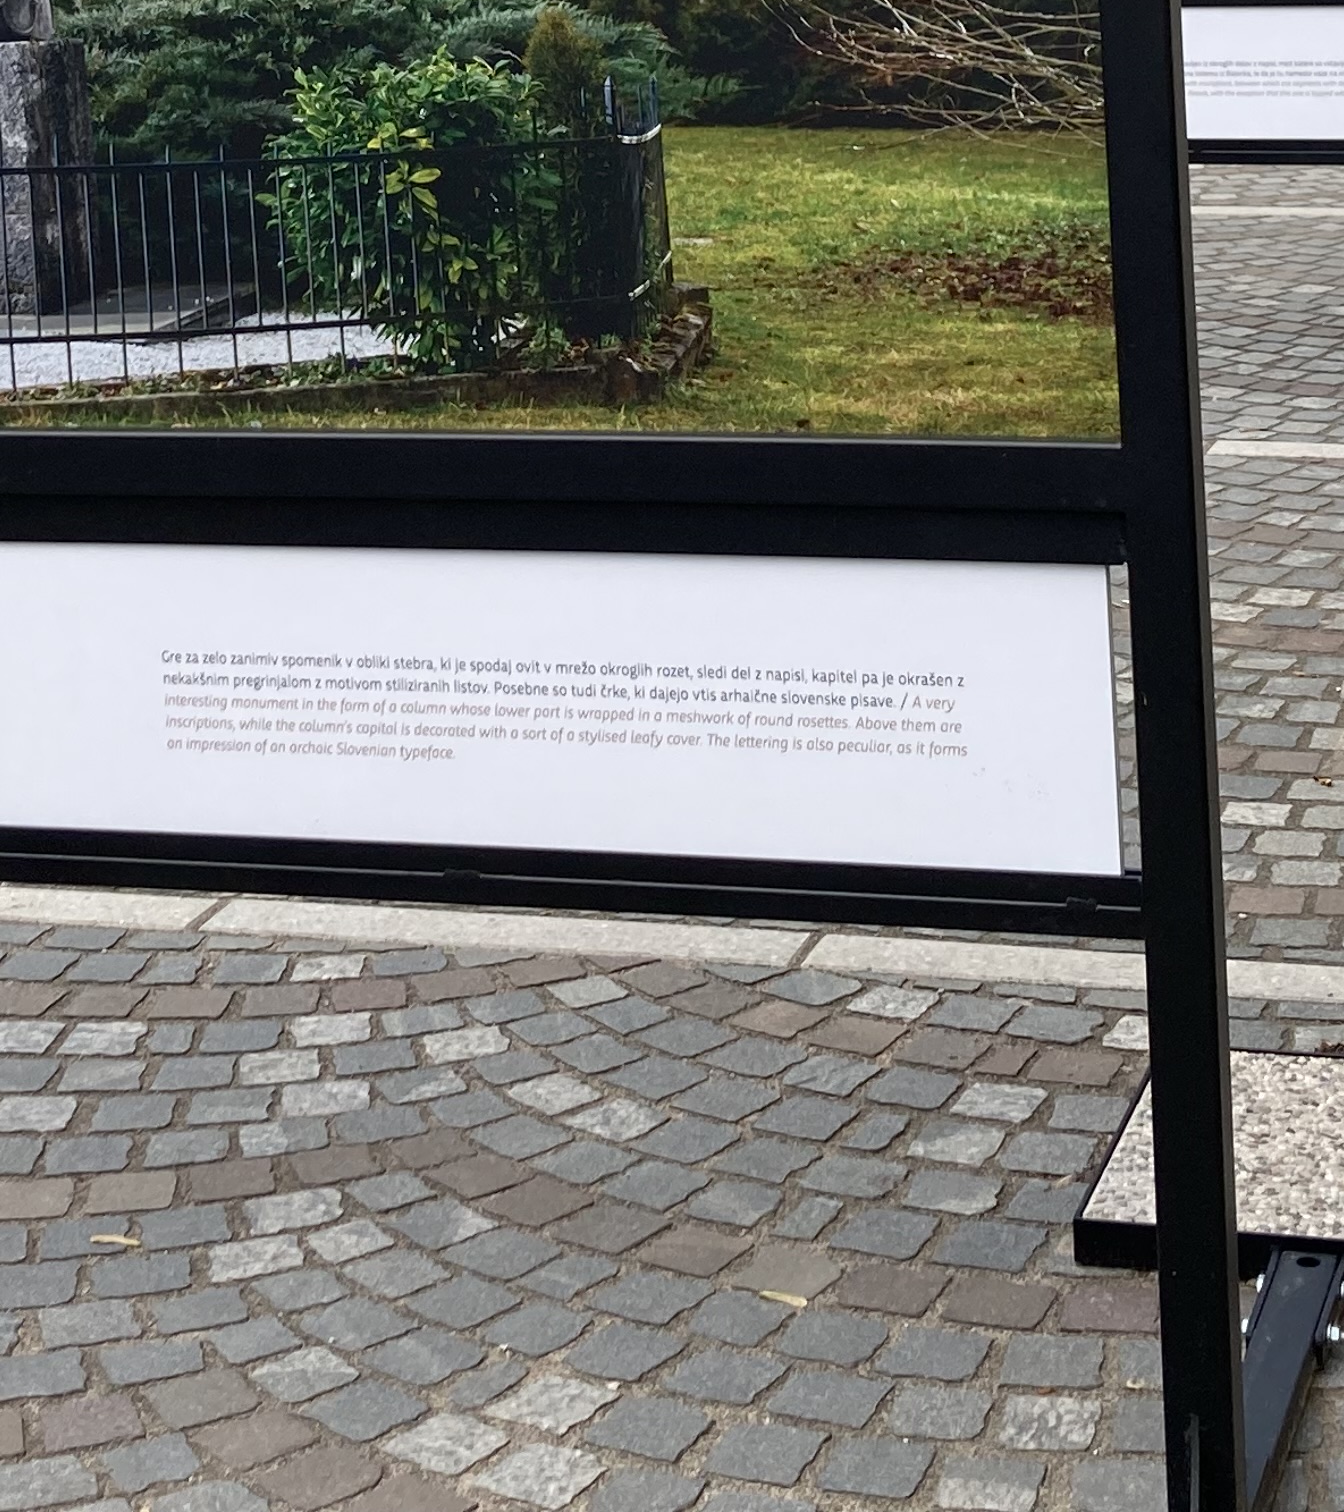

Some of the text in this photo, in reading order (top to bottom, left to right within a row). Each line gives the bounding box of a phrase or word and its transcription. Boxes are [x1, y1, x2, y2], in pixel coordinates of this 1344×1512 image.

[160, 649, 182, 663] Gre
[184, 653, 199, 663] za
[201, 651, 227, 664] zelo
[229, 652, 278, 666] zanimiv
[280, 654, 342, 670] spomenik
[344, 658, 353, 668] v
[355, 655, 390, 669] obliki
[439, 658, 451, 671] ki
[454, 658, 466, 675] je
[469, 659, 512, 677] spodaj
[514, 660, 541, 674] ovit
[543, 664, 552, 674] v
[555, 662, 596, 675] mrežo
[599, 663, 653, 681] okroglih
[696, 666, 727, 679] sledi
[730, 666, 751, 680] del
[754, 670, 762, 680] z
[811, 669, 857, 687] kapitel
[861, 674, 879, 688] pa
[881, 671, 894, 688] je
[897, 672, 953, 686] okrašen
[956, 676, 964, 686] z
[162, 673, 229, 687] nekakšnim
[233, 675, 311, 693] pregrinjalom
[314, 680, 321, 690] z
[324, 677, 382, 692] motivom
[385, 679, 450, 694] stiliziranih
[493, 682, 549, 697] Posebne
[552, 687, 567, 697] so
[570, 684, 596, 698] tudi
[633, 686, 645, 699] ki
[648, 686, 688, 705] dajejo
[691, 688, 716, 702] vtis
[719, 689, 777, 703] arhaične
[780, 691, 846, 705] slovenske
[911, 694, 921, 707] A
[925, 698, 955, 713] very
